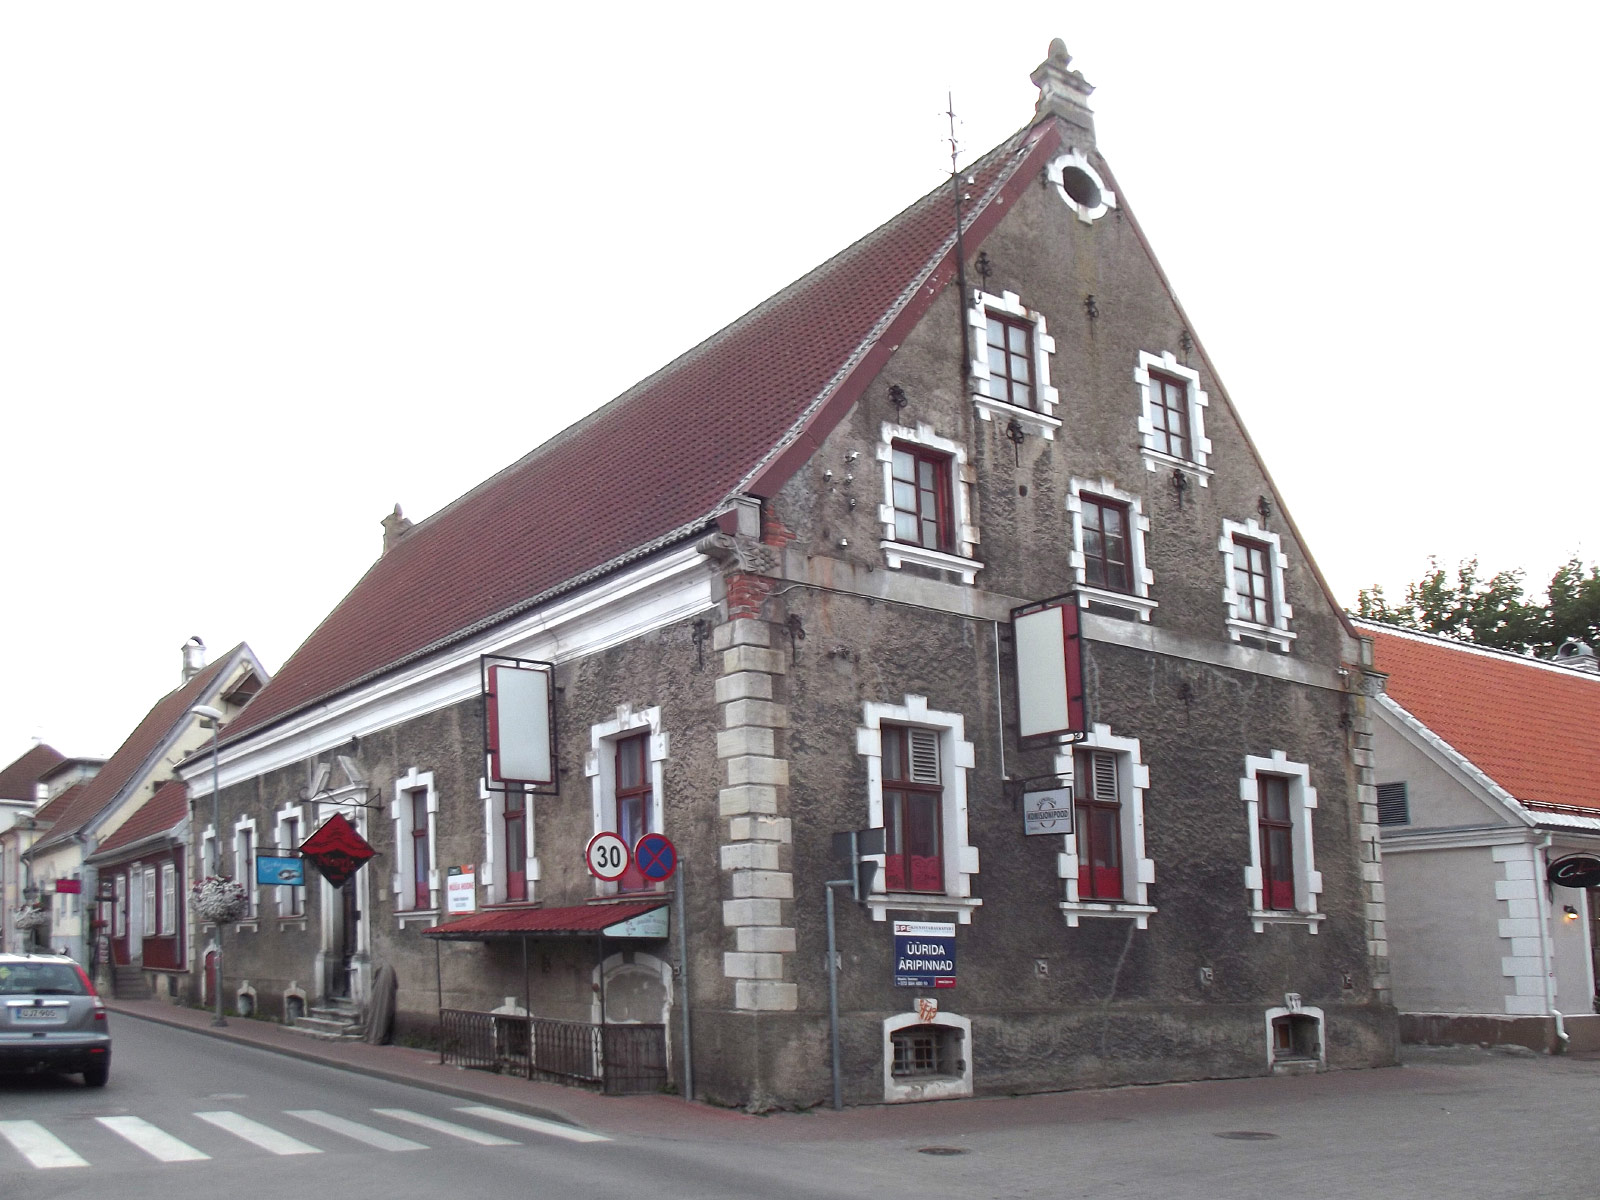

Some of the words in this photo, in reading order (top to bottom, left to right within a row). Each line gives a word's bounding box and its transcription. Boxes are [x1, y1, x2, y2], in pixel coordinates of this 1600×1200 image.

[597, 845, 621, 868] 30
[907, 941, 946, 955] ÜÜRIDA
[898, 956, 953, 971] ÄRIPINNAD
